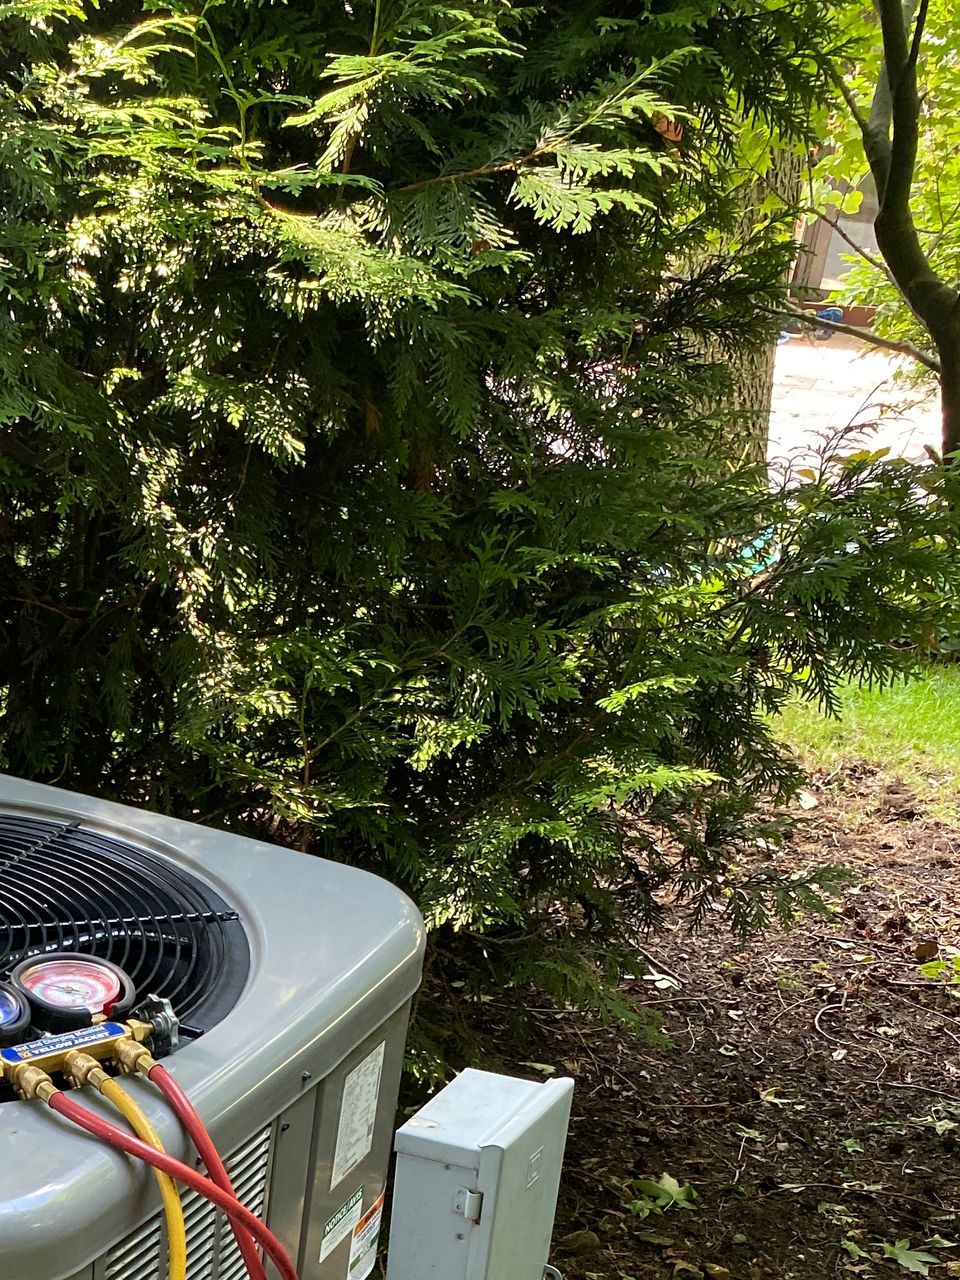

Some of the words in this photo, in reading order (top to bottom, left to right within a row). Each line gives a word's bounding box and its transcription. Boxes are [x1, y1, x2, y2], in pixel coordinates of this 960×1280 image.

[32, 1042, 73, 1054] YELLOW
[73, 1031, 111, 1045] JACKET
[43, 1033, 76, 1045] Charging
